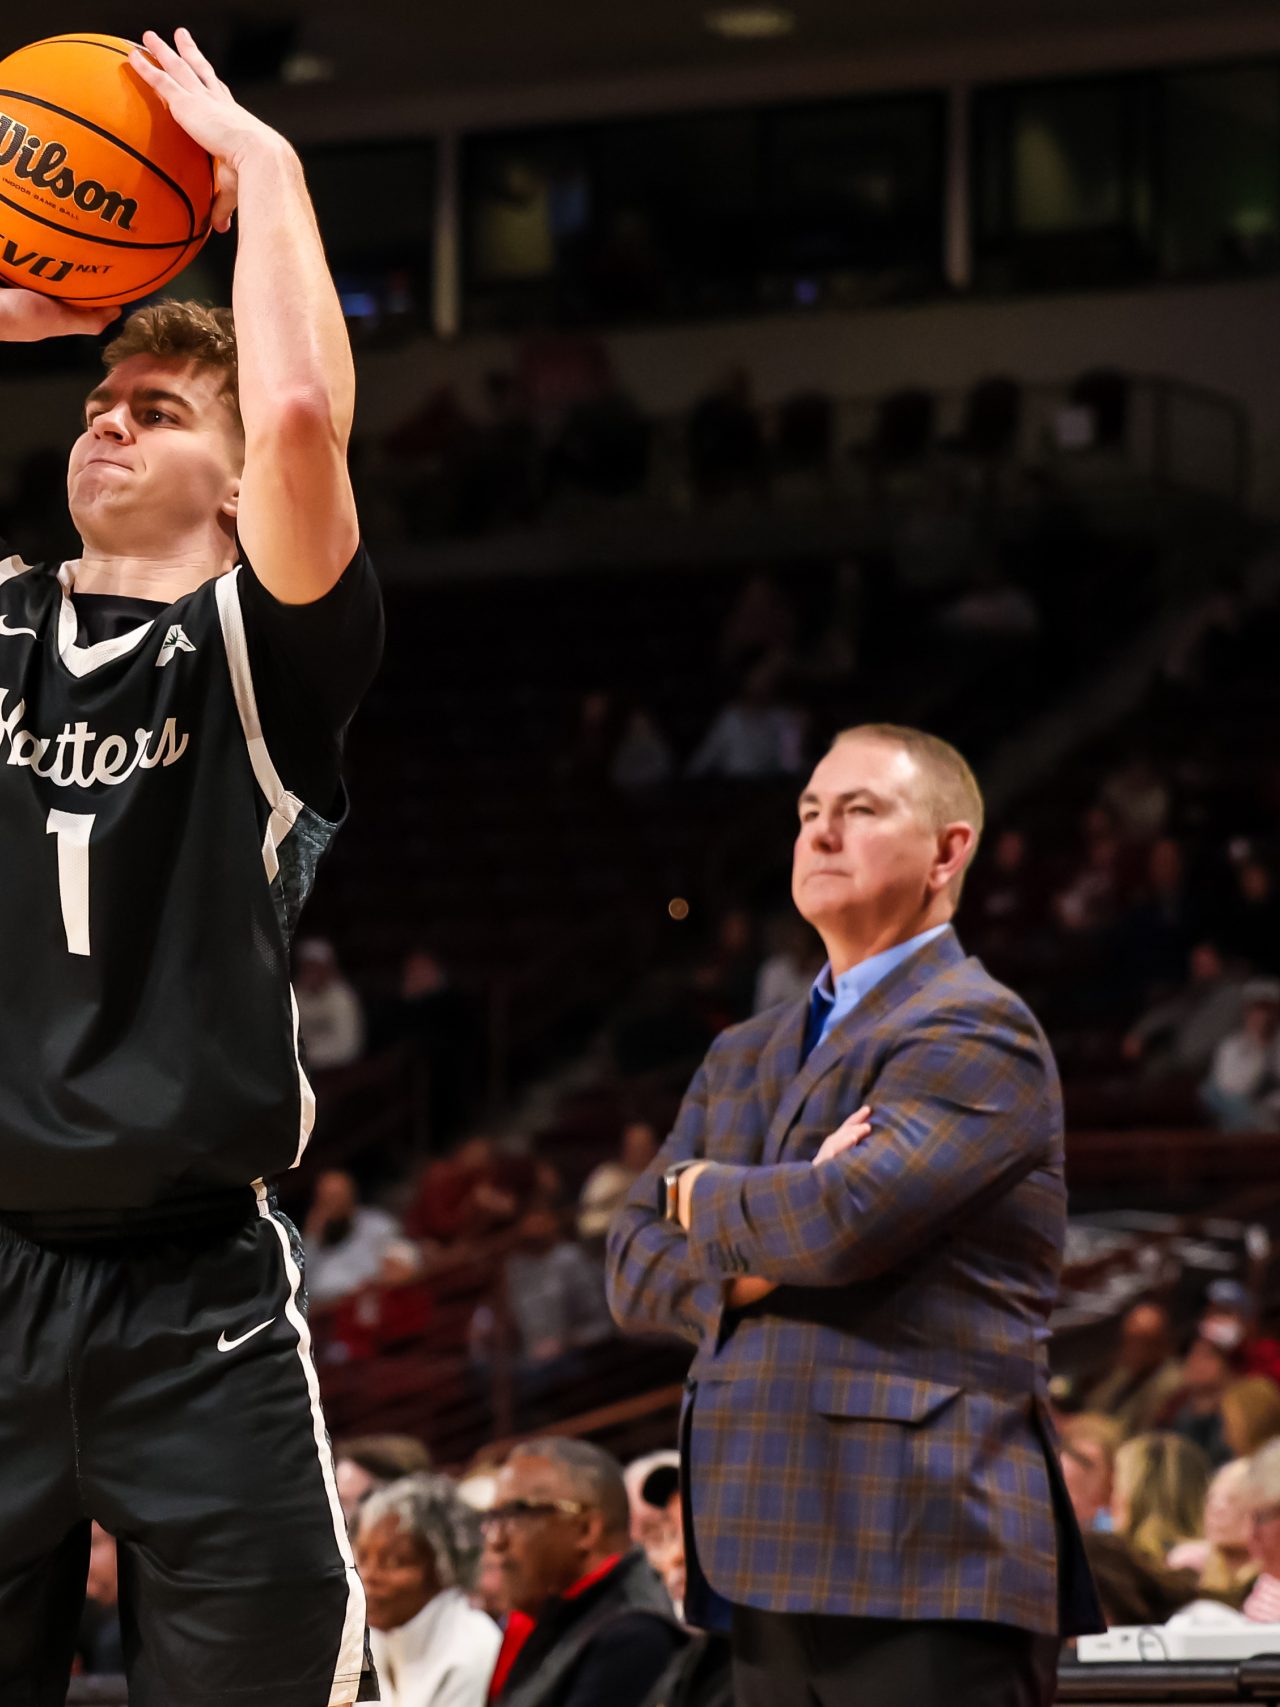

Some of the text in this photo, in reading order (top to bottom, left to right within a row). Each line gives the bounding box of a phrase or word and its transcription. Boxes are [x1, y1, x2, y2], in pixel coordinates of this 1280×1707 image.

[2, 177, 79, 220] INDOOR GAME BALL
[75, 264, 112, 274] NXT
[46, 808, 96, 956] 1
